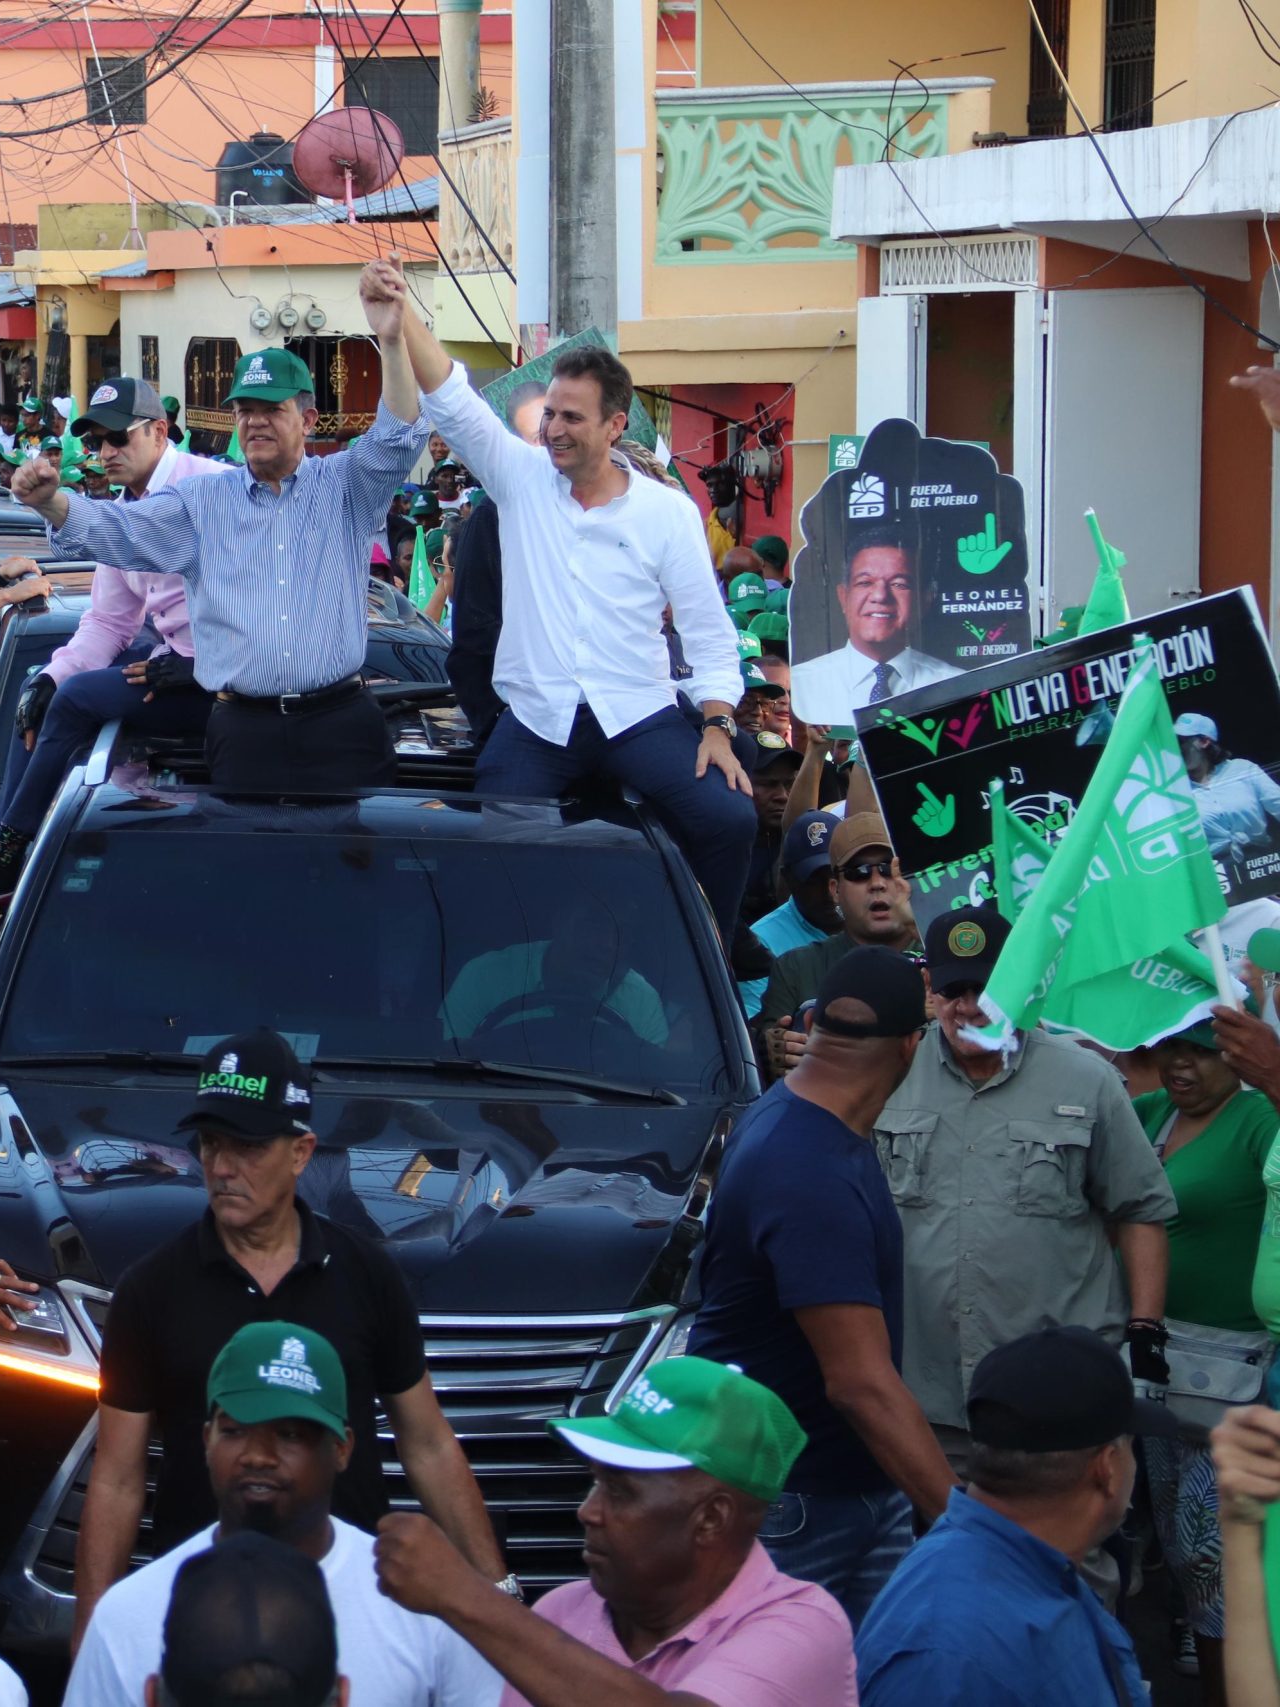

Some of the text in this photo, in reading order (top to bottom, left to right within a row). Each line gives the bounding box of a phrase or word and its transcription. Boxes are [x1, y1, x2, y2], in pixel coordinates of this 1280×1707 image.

[910, 484, 953, 496] FUERZA
[910, 494, 978, 508] DEL PUEBLO
[852, 505, 880, 516] FP
[942, 588, 1023, 602] LEONEL
[942, 600, 1023, 614] FERNÁNDEZ
[956, 645, 978, 656] NUEVA
[991, 672, 1070, 730] NUEVA
[1008, 710, 1085, 741] FUERZA
[1250, 867, 1267, 880] DEL
[1111, 955, 1208, 996] UEBLO
[199, 1071, 268, 1094] Leonel
[258, 1364, 322, 1391] LEONEL
